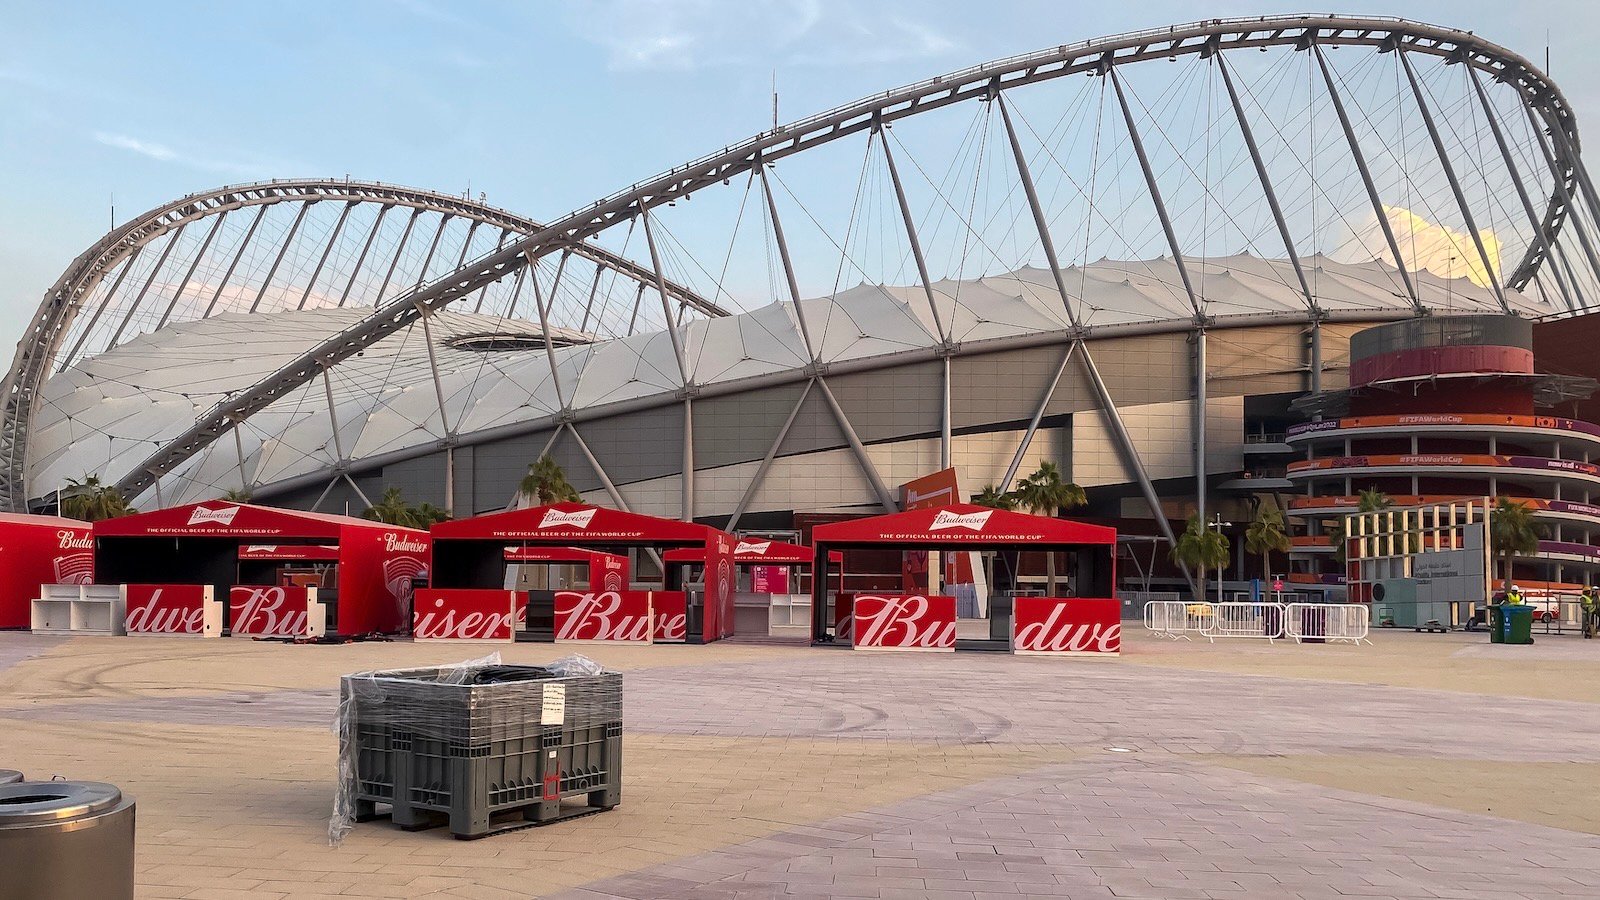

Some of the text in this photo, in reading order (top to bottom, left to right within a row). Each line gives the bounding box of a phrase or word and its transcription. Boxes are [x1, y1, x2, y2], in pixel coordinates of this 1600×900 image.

[1399, 456, 1463, 464] #FIFAWorldCup
[192, 509, 234, 520] Budweiser
[544, 512, 592, 522] Budweiser
[935, 513, 986, 524] Budweiser
[384, 532, 428, 552] Budweiser
[414, 598, 514, 639] iser
[855, 596, 956, 648] Bu
[1014, 603, 1120, 652] dwe
